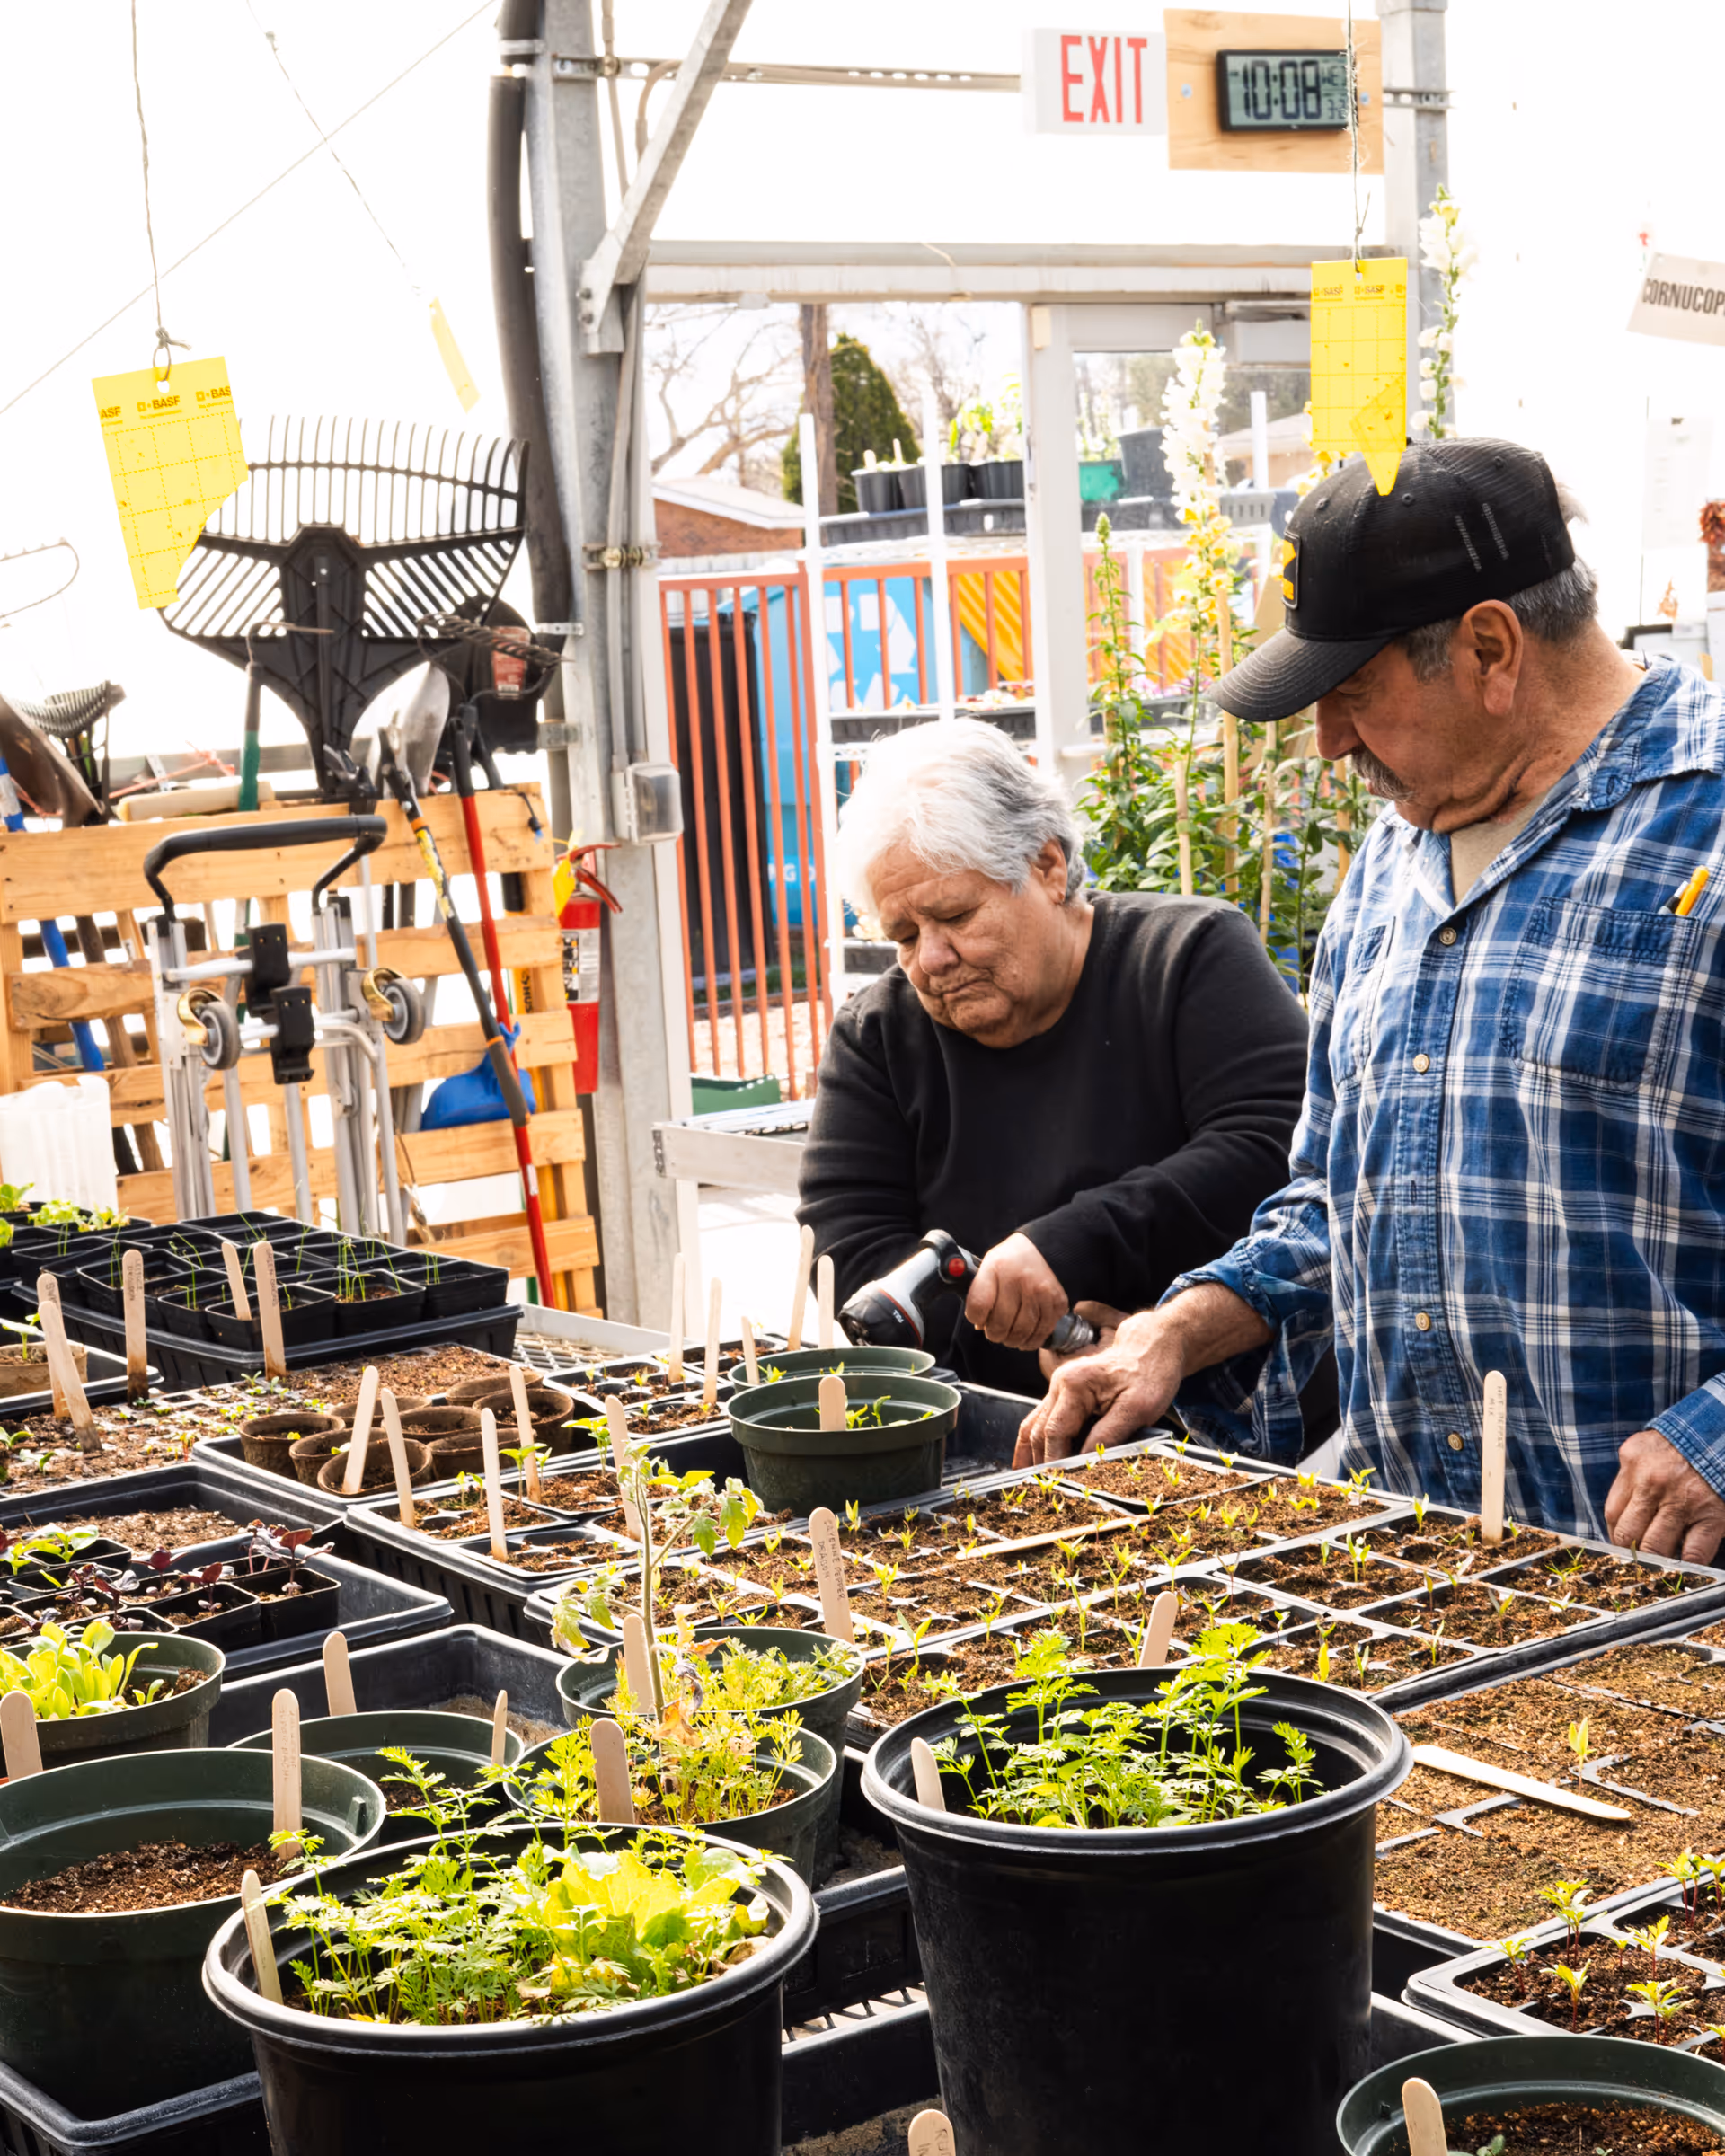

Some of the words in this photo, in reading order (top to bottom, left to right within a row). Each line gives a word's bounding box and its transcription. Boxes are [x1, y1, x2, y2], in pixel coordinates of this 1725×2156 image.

[1060, 35, 1147, 124] EXIT
[1243, 59, 1322, 120] 10:08
[1642, 278, 1725, 316] CORNUCOP
[152, 395, 181, 410] BASF
[818, 1540, 831, 1579] DRAGON
[824, 1519, 841, 1563] CAYENNE
[834, 1567, 846, 1601] PEPPER
